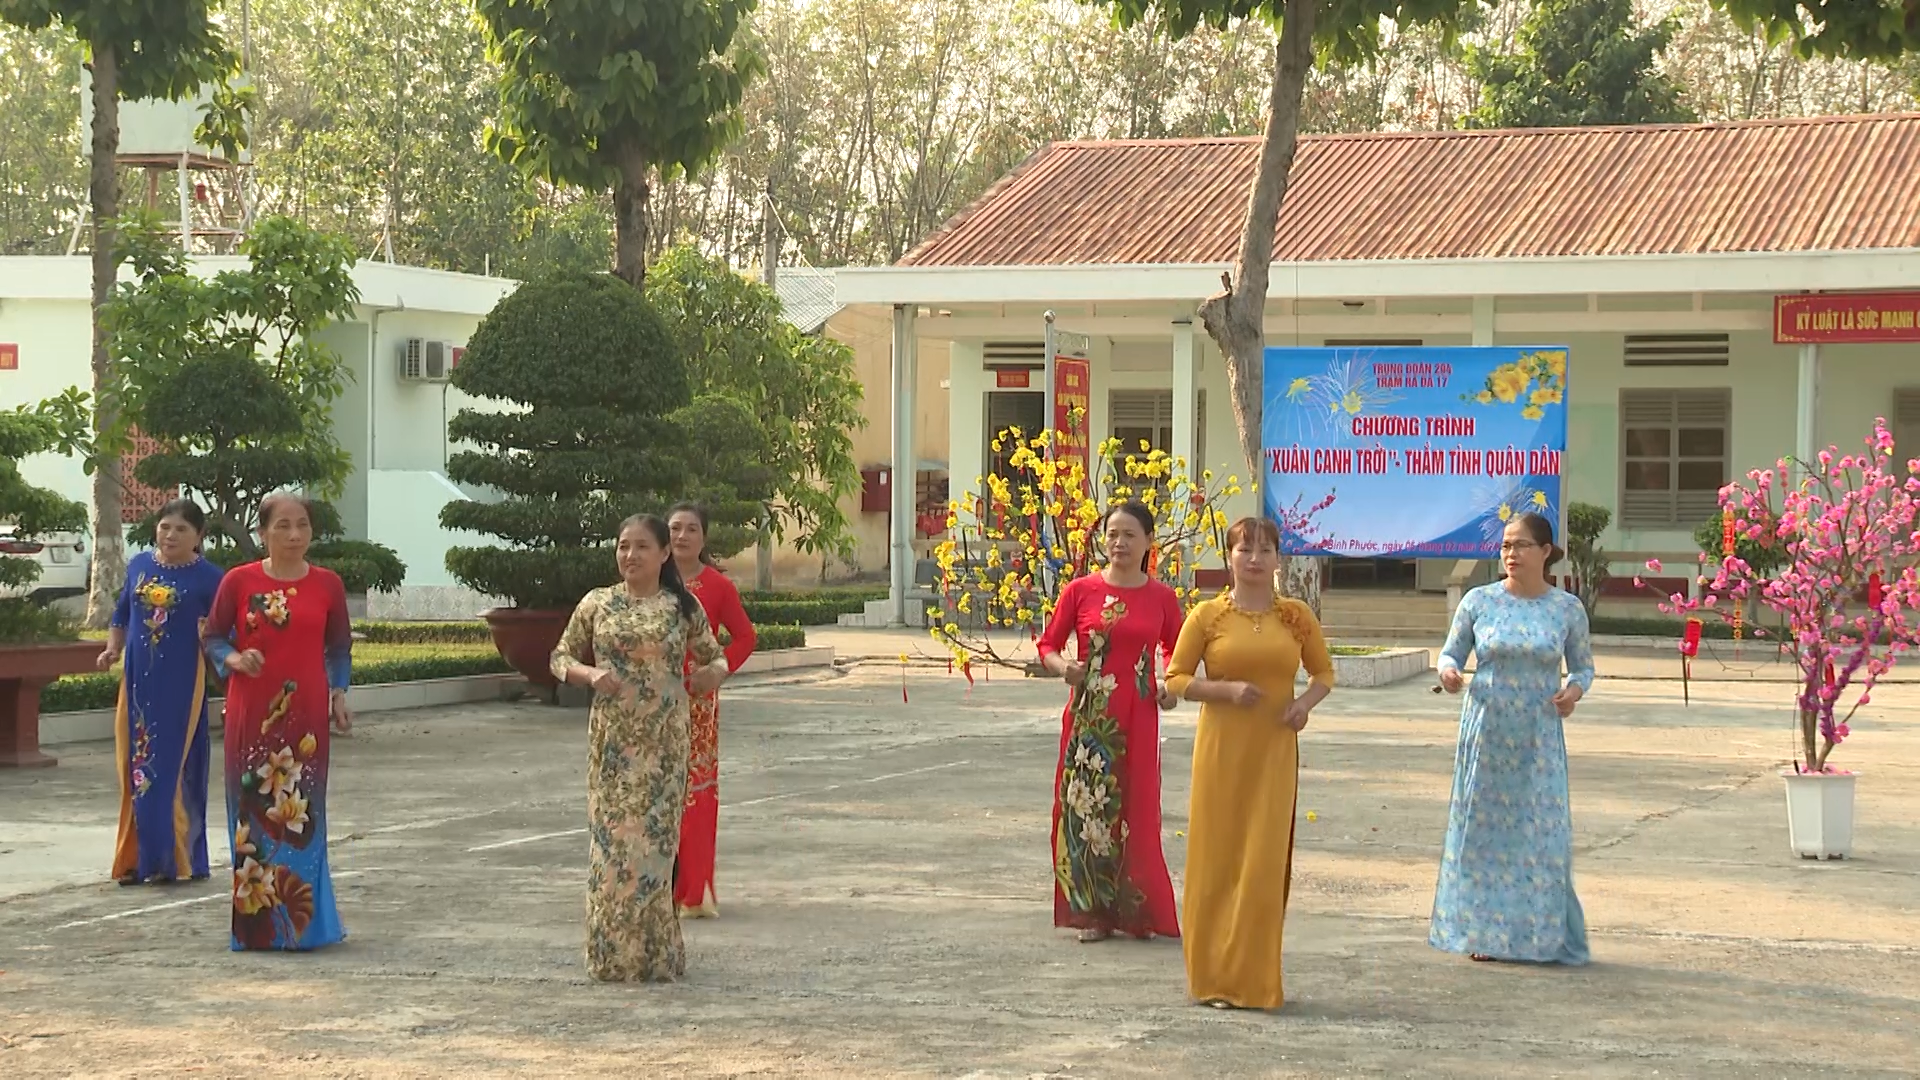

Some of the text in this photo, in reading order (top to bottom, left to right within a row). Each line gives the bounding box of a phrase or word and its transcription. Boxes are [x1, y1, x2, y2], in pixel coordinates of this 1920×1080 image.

[1812, 307, 1839, 334] LUẬT
[1841, 307, 1855, 330] LÀ
[1856, 305, 1879, 330] SỨC
[1881, 310, 1914, 333] MẠNH
[1372, 362, 1403, 375] TRUNG
[1437, 376, 1448, 388] 17
[1351, 413, 1476, 437] CHƯƠNG TRÌNH
[1265, 443, 1311, 474] "XUÂN
[1313, 448, 1353, 474] CANH
[1448, 443, 1482, 475] TÌNH
[1485, 443, 1526, 479] QUÂN
[1529, 443, 1561, 475] DÂN
